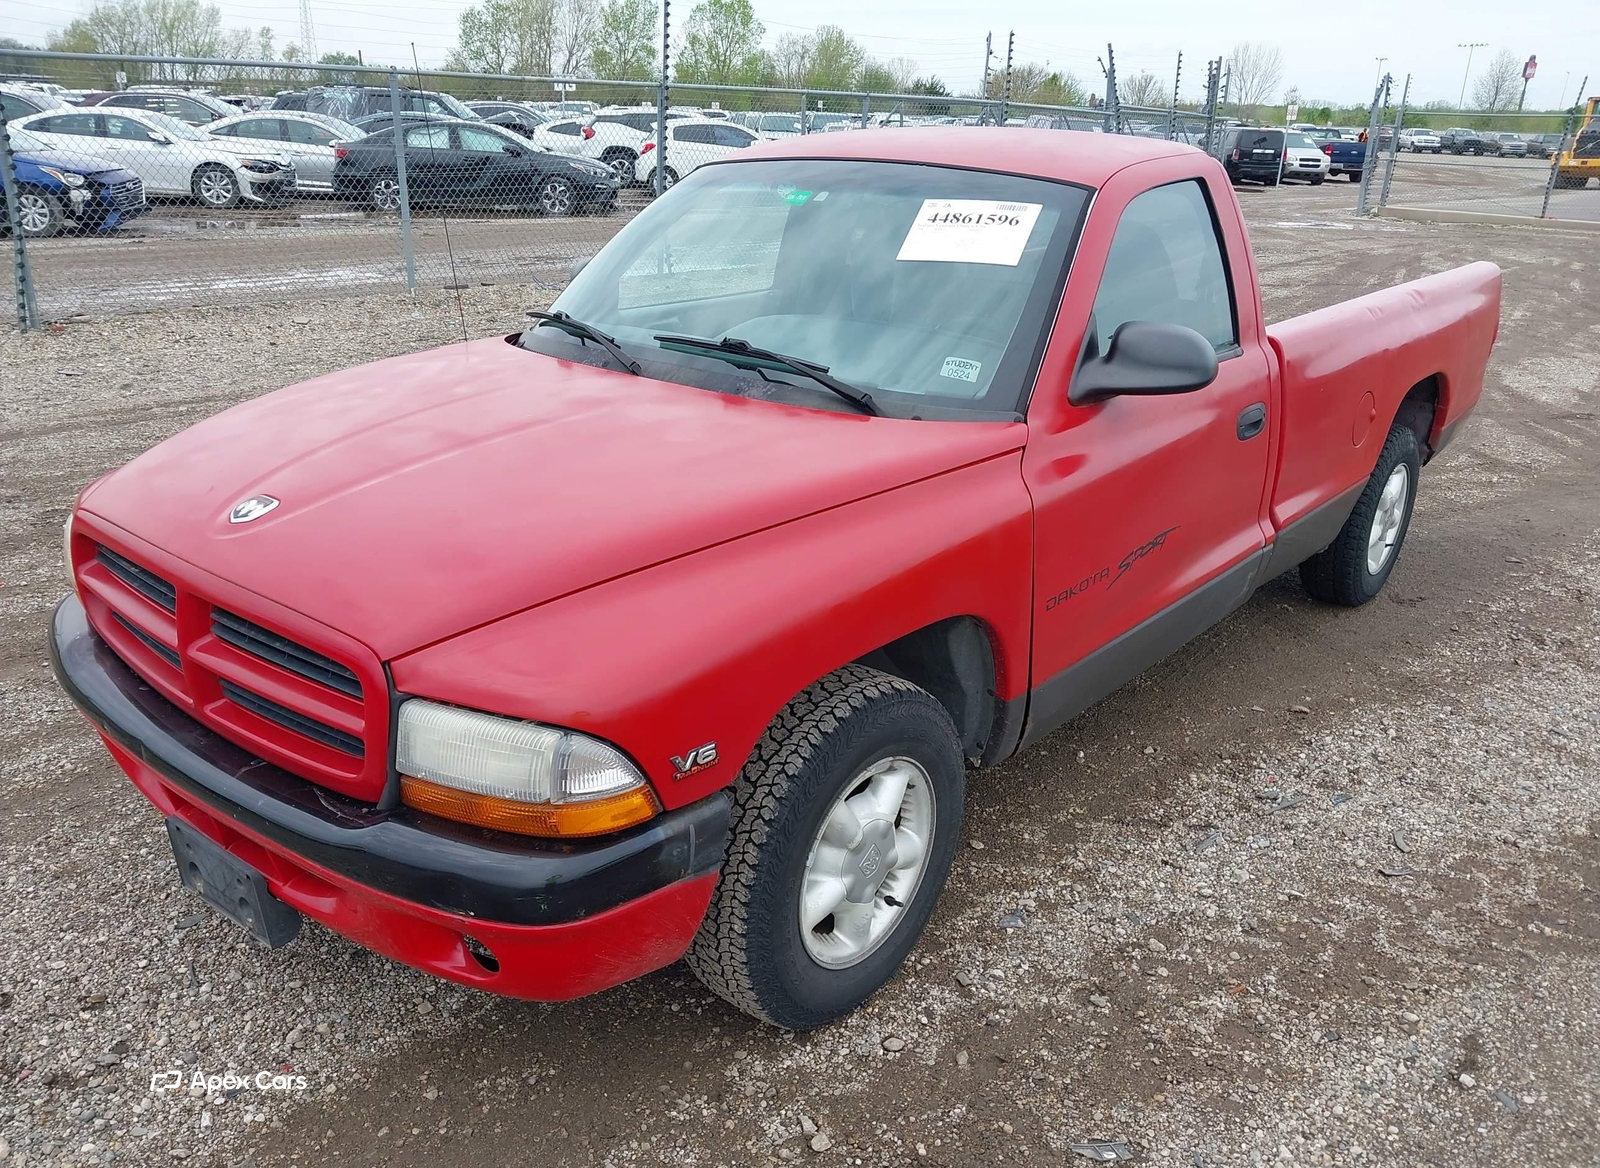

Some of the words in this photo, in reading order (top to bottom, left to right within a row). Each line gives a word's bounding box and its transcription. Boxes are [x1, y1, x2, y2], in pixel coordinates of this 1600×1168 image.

[927, 212, 1021, 227] 44861596
[945, 359, 979, 371] STUDENT
[947, 368, 971, 379] 0524
[1045, 567, 1110, 612] DAKOTA
[1106, 525, 1181, 590] SPORT
[669, 740, 717, 772] V6
